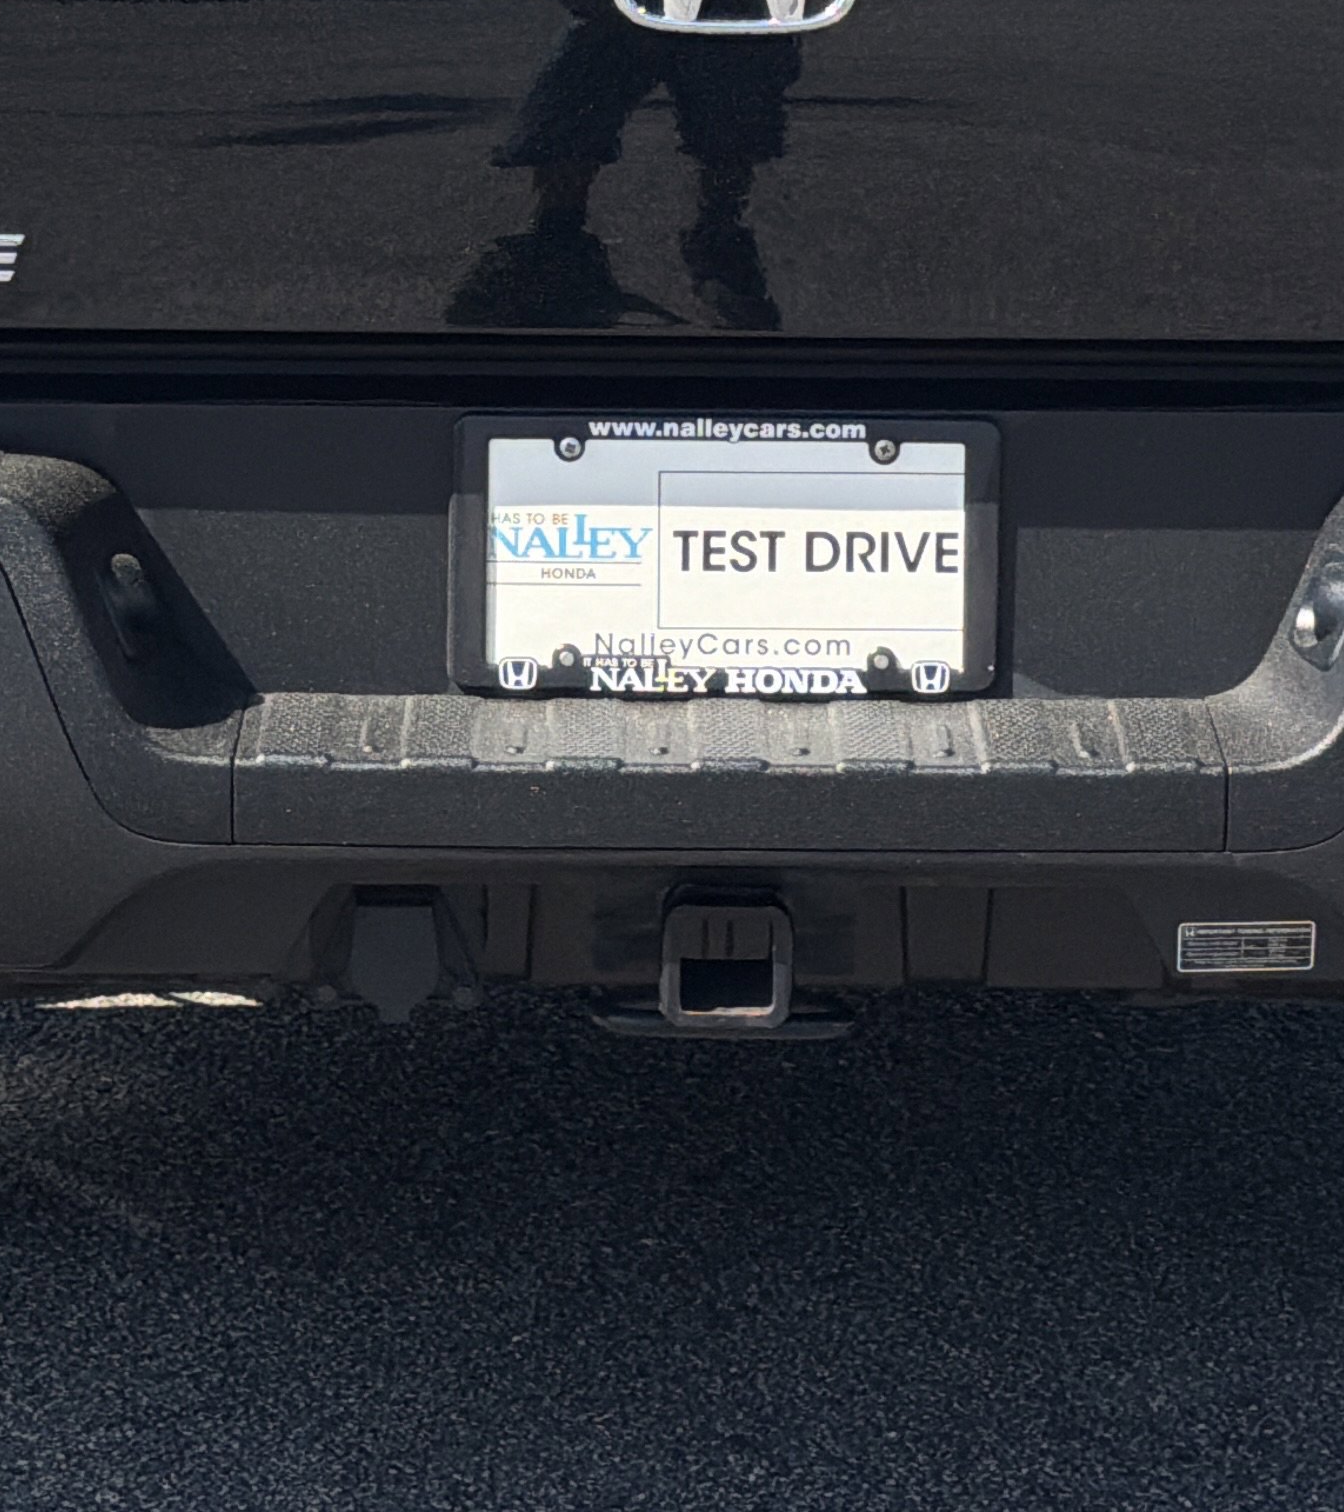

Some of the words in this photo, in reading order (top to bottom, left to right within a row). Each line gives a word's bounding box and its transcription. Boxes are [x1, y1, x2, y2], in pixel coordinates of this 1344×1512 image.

[588, 418, 867, 442] www.nalleycars.com
[491, 512, 521, 525] HAS
[526, 513, 546, 525] TO
[552, 513, 569, 525] BE
[487, 513, 654, 559] NALLEY
[672, 530, 786, 572] TEST
[805, 531, 959, 573] DRIVE
[540, 567, 596, 580] HONDA
[594, 632, 852, 659] NalleyCars.com
[589, 658, 717, 693] NALLEY
[724, 668, 869, 695] HONDA
